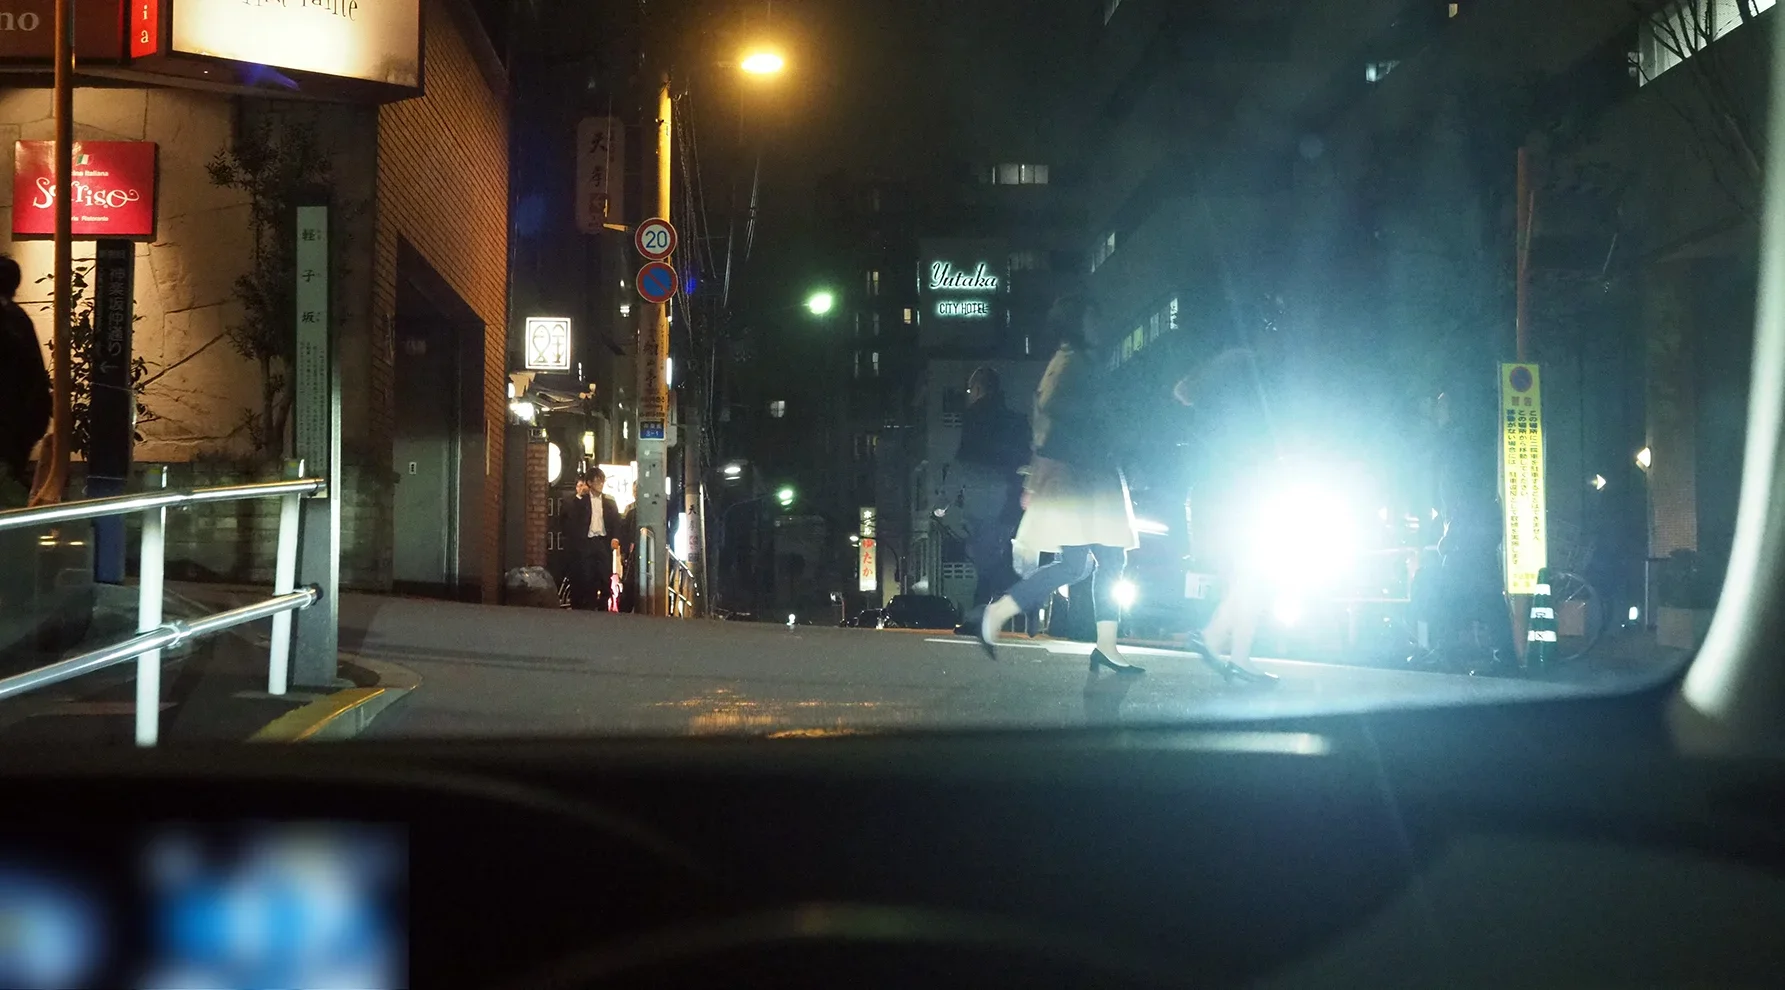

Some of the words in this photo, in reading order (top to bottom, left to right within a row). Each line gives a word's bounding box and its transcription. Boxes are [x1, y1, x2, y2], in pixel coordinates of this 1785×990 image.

[645, 230, 668, 248] 20
[930, 261, 998, 289] Yutaka
[938, 302, 959, 315] CITY
[961, 302, 987, 316] HOTEL
